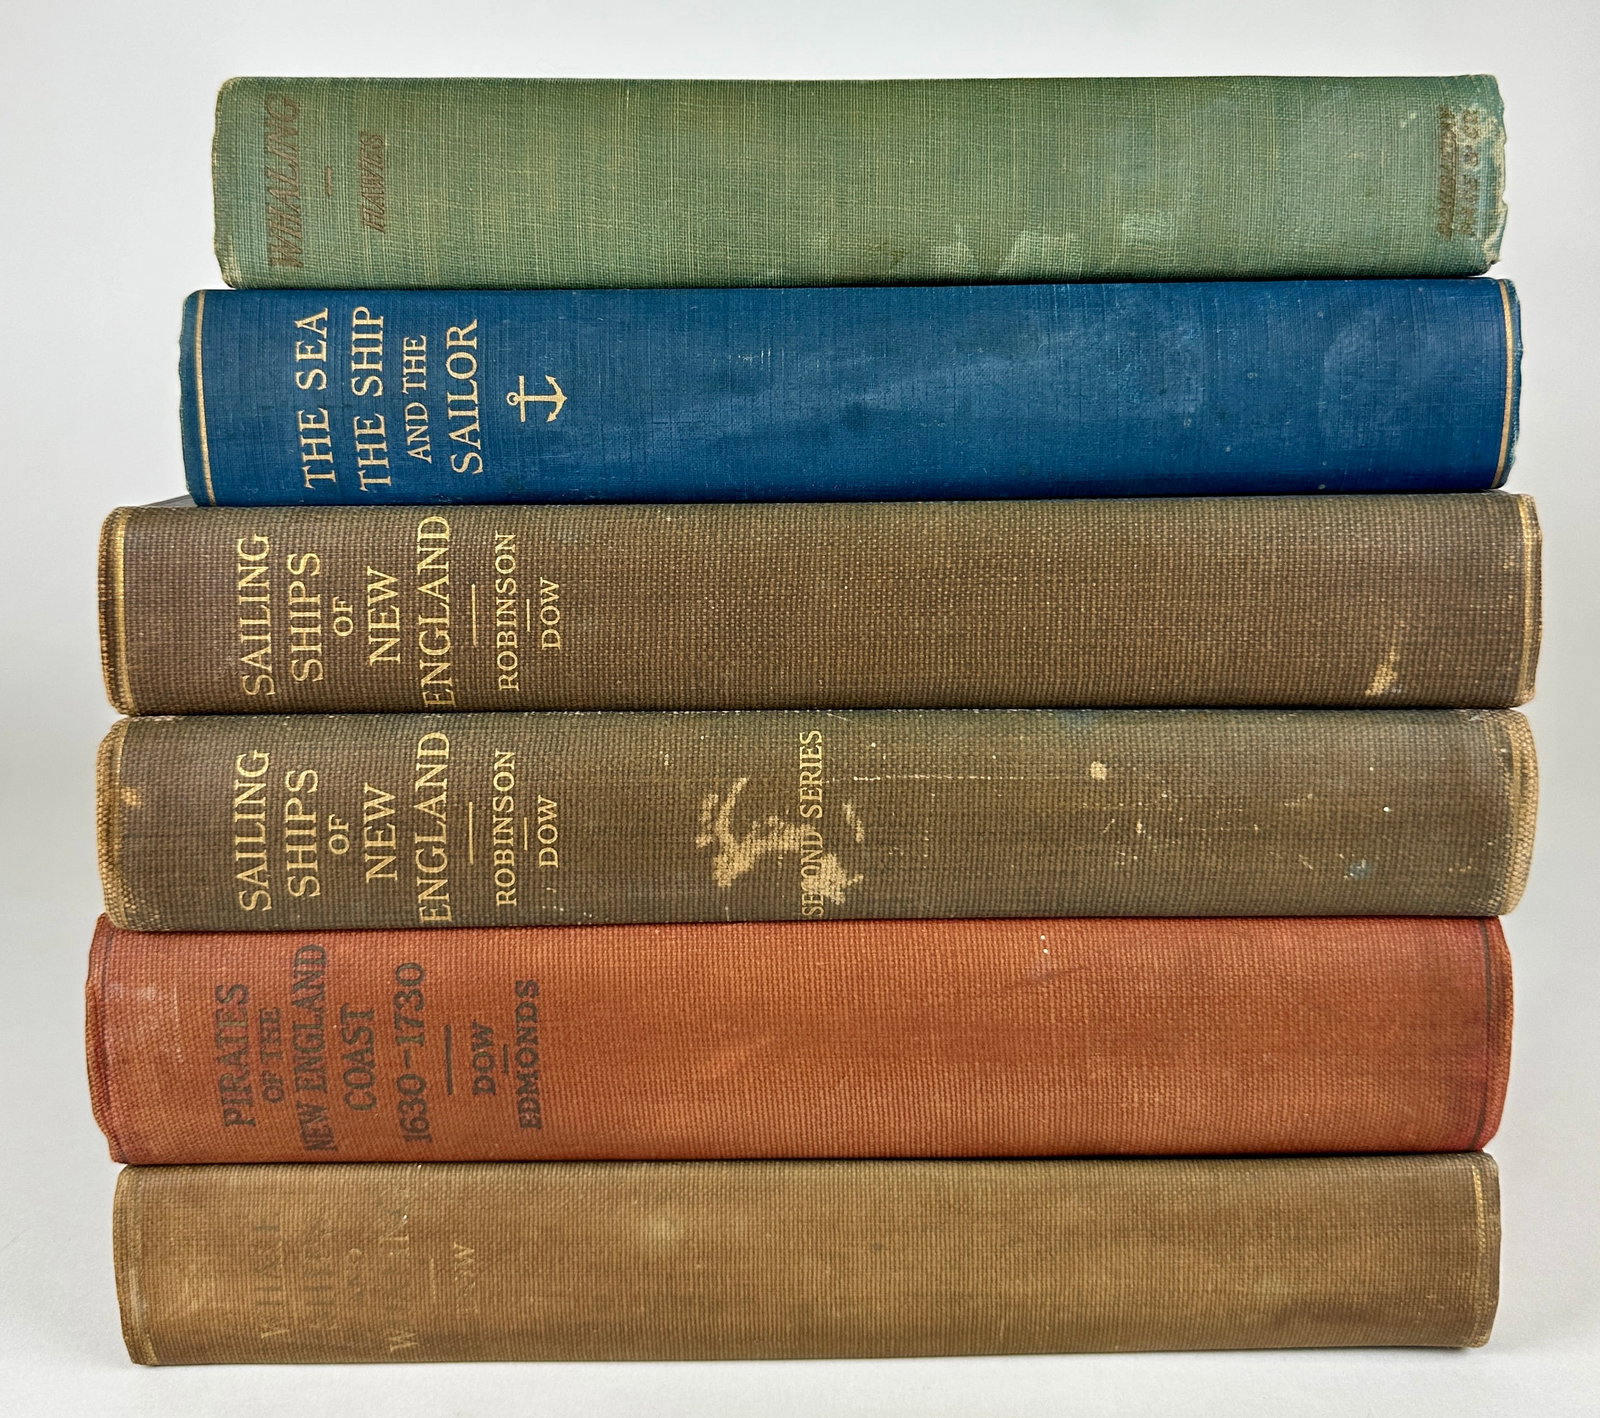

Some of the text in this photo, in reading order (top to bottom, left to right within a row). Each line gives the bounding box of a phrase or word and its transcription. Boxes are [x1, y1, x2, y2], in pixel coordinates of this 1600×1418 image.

[265, 94, 303, 268] WHALING
[359, 131, 386, 234] HAWES
[294, 308, 336, 489] THE SEA
[351, 306, 392, 492] THE SHIP
[402, 334, 432, 463] AND THE
[446, 318, 483, 475] SAILOR
[237, 533, 275, 696] SAILING
[287, 552, 324, 682] SHIPS
[333, 596, 354, 637] OF
[367, 565, 400, 665] NEW
[417, 515, 455, 707] ENGLAND
[495, 530, 519, 691] ROBINSON
[540, 576, 561, 650] DOW
[234, 749, 271, 911] SAILING
[285, 769, 320, 897] SHIPS
[328, 814, 350, 855] OF
[363, 782, 398, 883] NEW
[414, 732, 453, 923] ENGLAND
[492, 748, 517, 906] ROBINSON
[538, 794, 558, 868] DOW
[800, 730, 823, 819] SERIES
[215, 982, 256, 1128] PIRATES
[259, 1006, 285, 1104] OF THE
[291, 944, 338, 1152] NEW ENGLAND
[340, 1003, 378, 1111] COAST
[393, 961, 432, 1143] 1630-1730
[471, 1019, 496, 1096] DOW
[514, 978, 542, 1130] EDMONDS
[378, 1184, 419, 1352] WING
